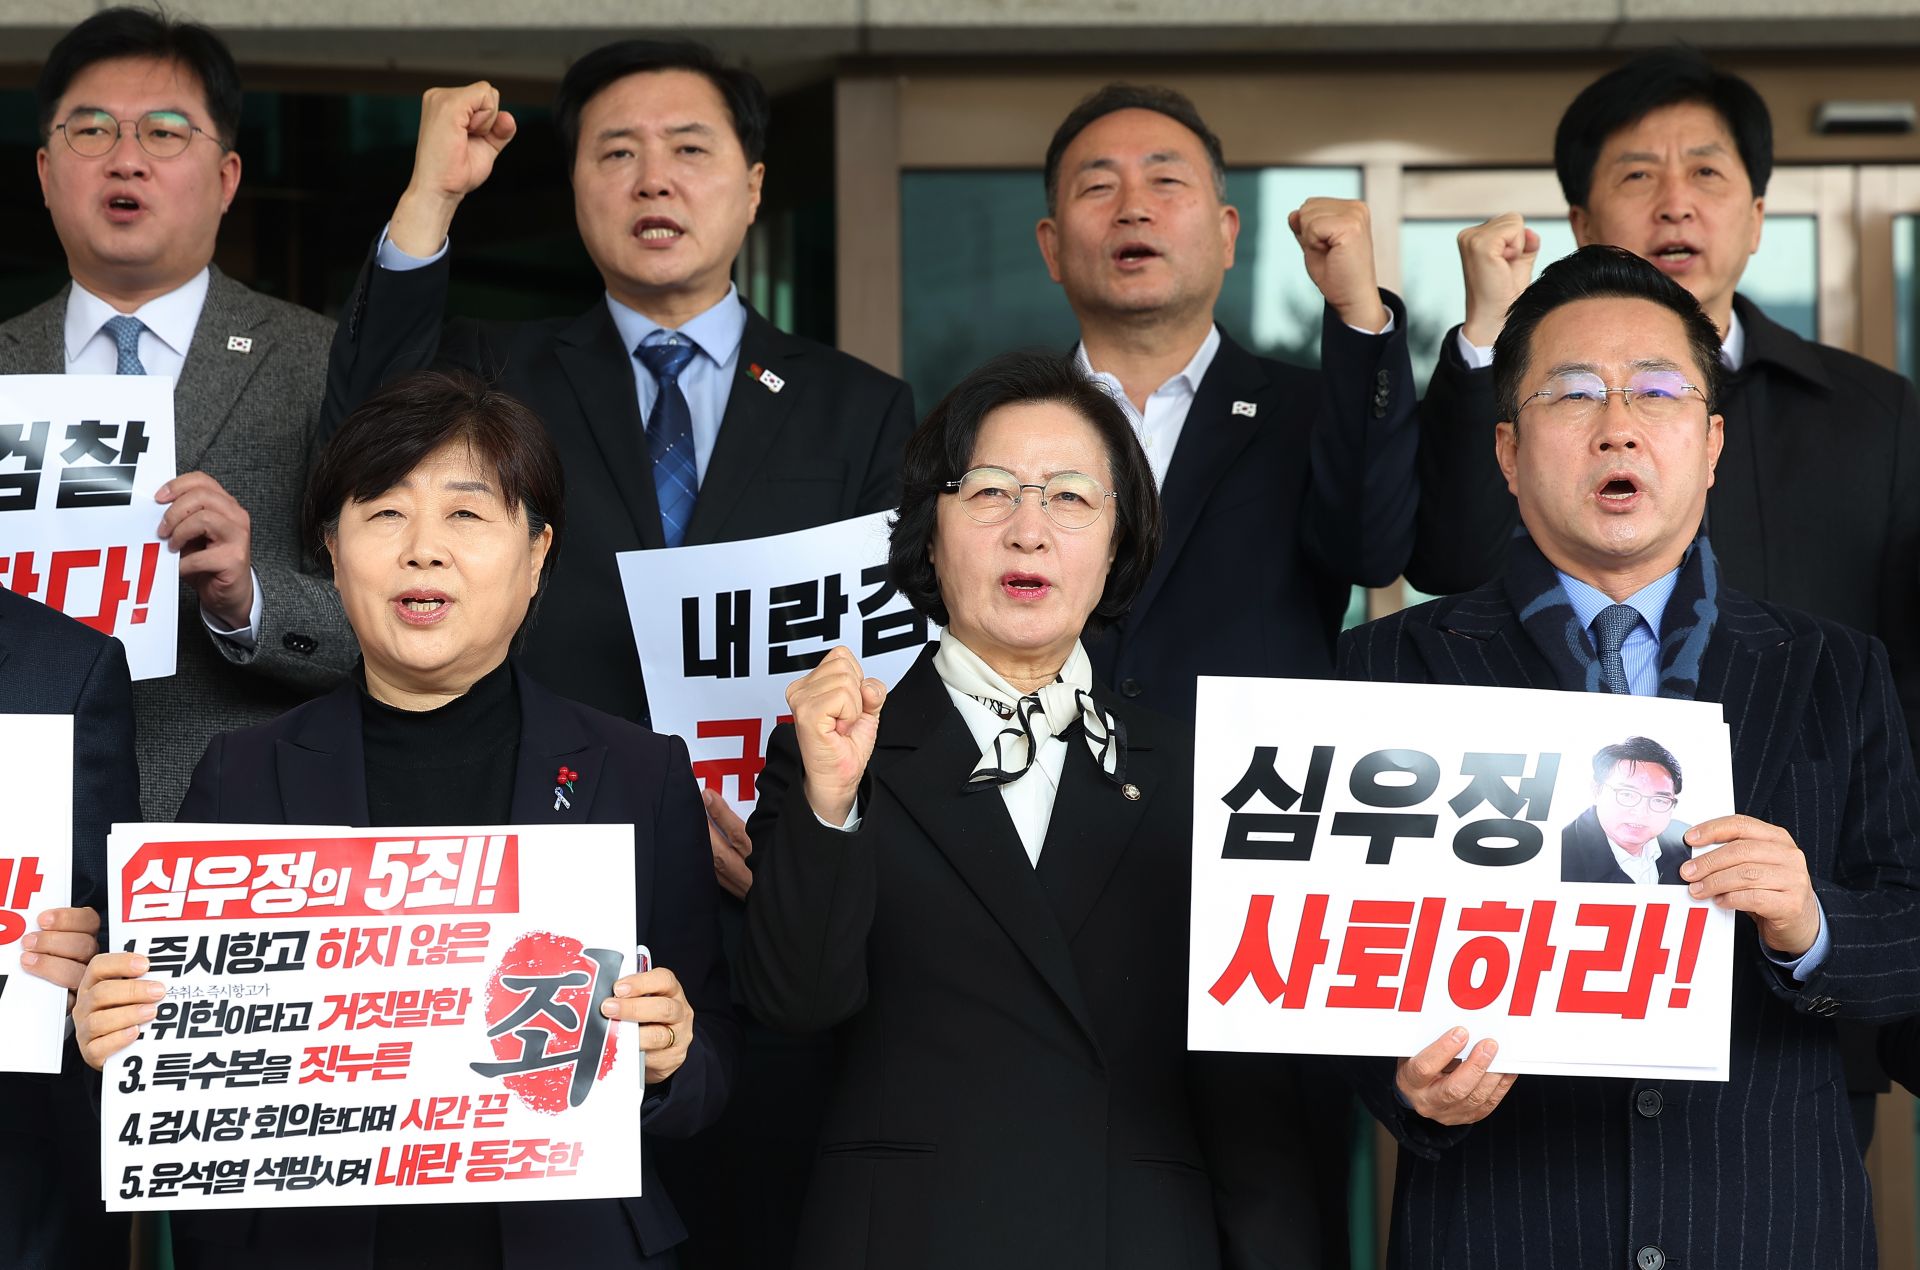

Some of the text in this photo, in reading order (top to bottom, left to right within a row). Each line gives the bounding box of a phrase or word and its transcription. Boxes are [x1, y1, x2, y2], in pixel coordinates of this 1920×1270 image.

[692, 714, 795, 802] 규
[1220, 745, 1562, 867] 심우정
[128, 851, 352, 921] 심우정의
[363, 835, 507, 912] 5죄!
[148, 930, 310, 978] 즉시항고
[316, 926, 402, 969] 하지
[407, 921, 491, 966] 않은
[1207, 893, 1709, 1020] 사퇴하라!
[151, 987, 472, 1040] 위헌이라고 거짓말한
[207, 983, 270, 998] 즉시항고가
[469, 948, 625, 1108] 죄
[118, 1041, 413, 1094] 3. 특수본을 짓누른
[118, 1093, 510, 1146] 4. 검사장 회의한대며 시간 끈
[119, 1138, 584, 1200] 5. 윤석열 석방시켜 내란 동조한
